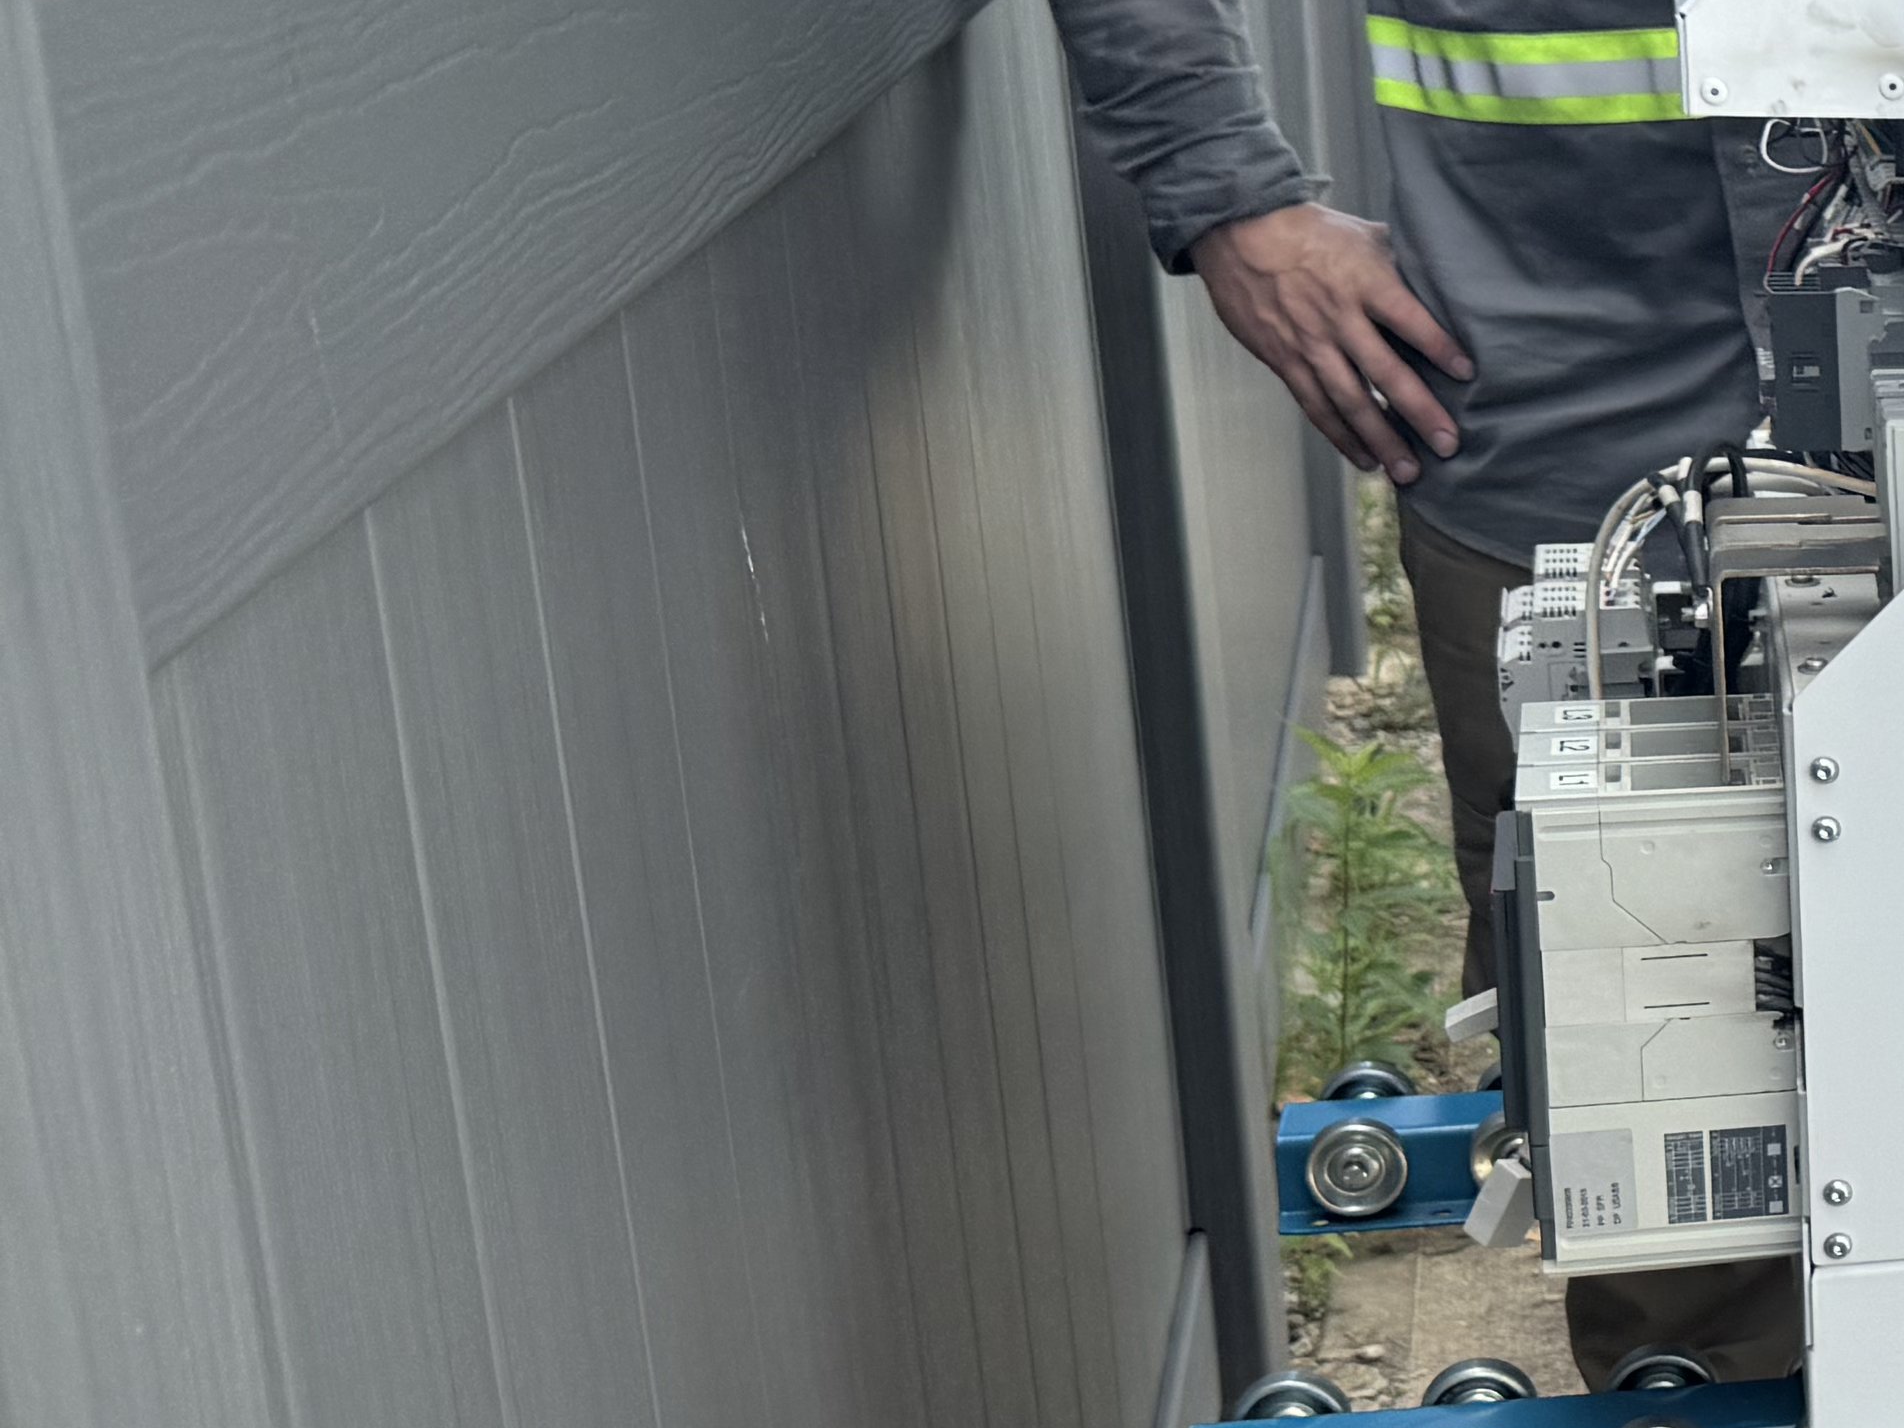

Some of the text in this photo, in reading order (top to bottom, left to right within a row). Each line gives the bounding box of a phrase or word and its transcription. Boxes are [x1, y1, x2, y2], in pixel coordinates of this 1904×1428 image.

[1562, 709, 1593, 720] L3
[1560, 739, 1590, 752] L2
[1558, 774, 1590, 785] L1
